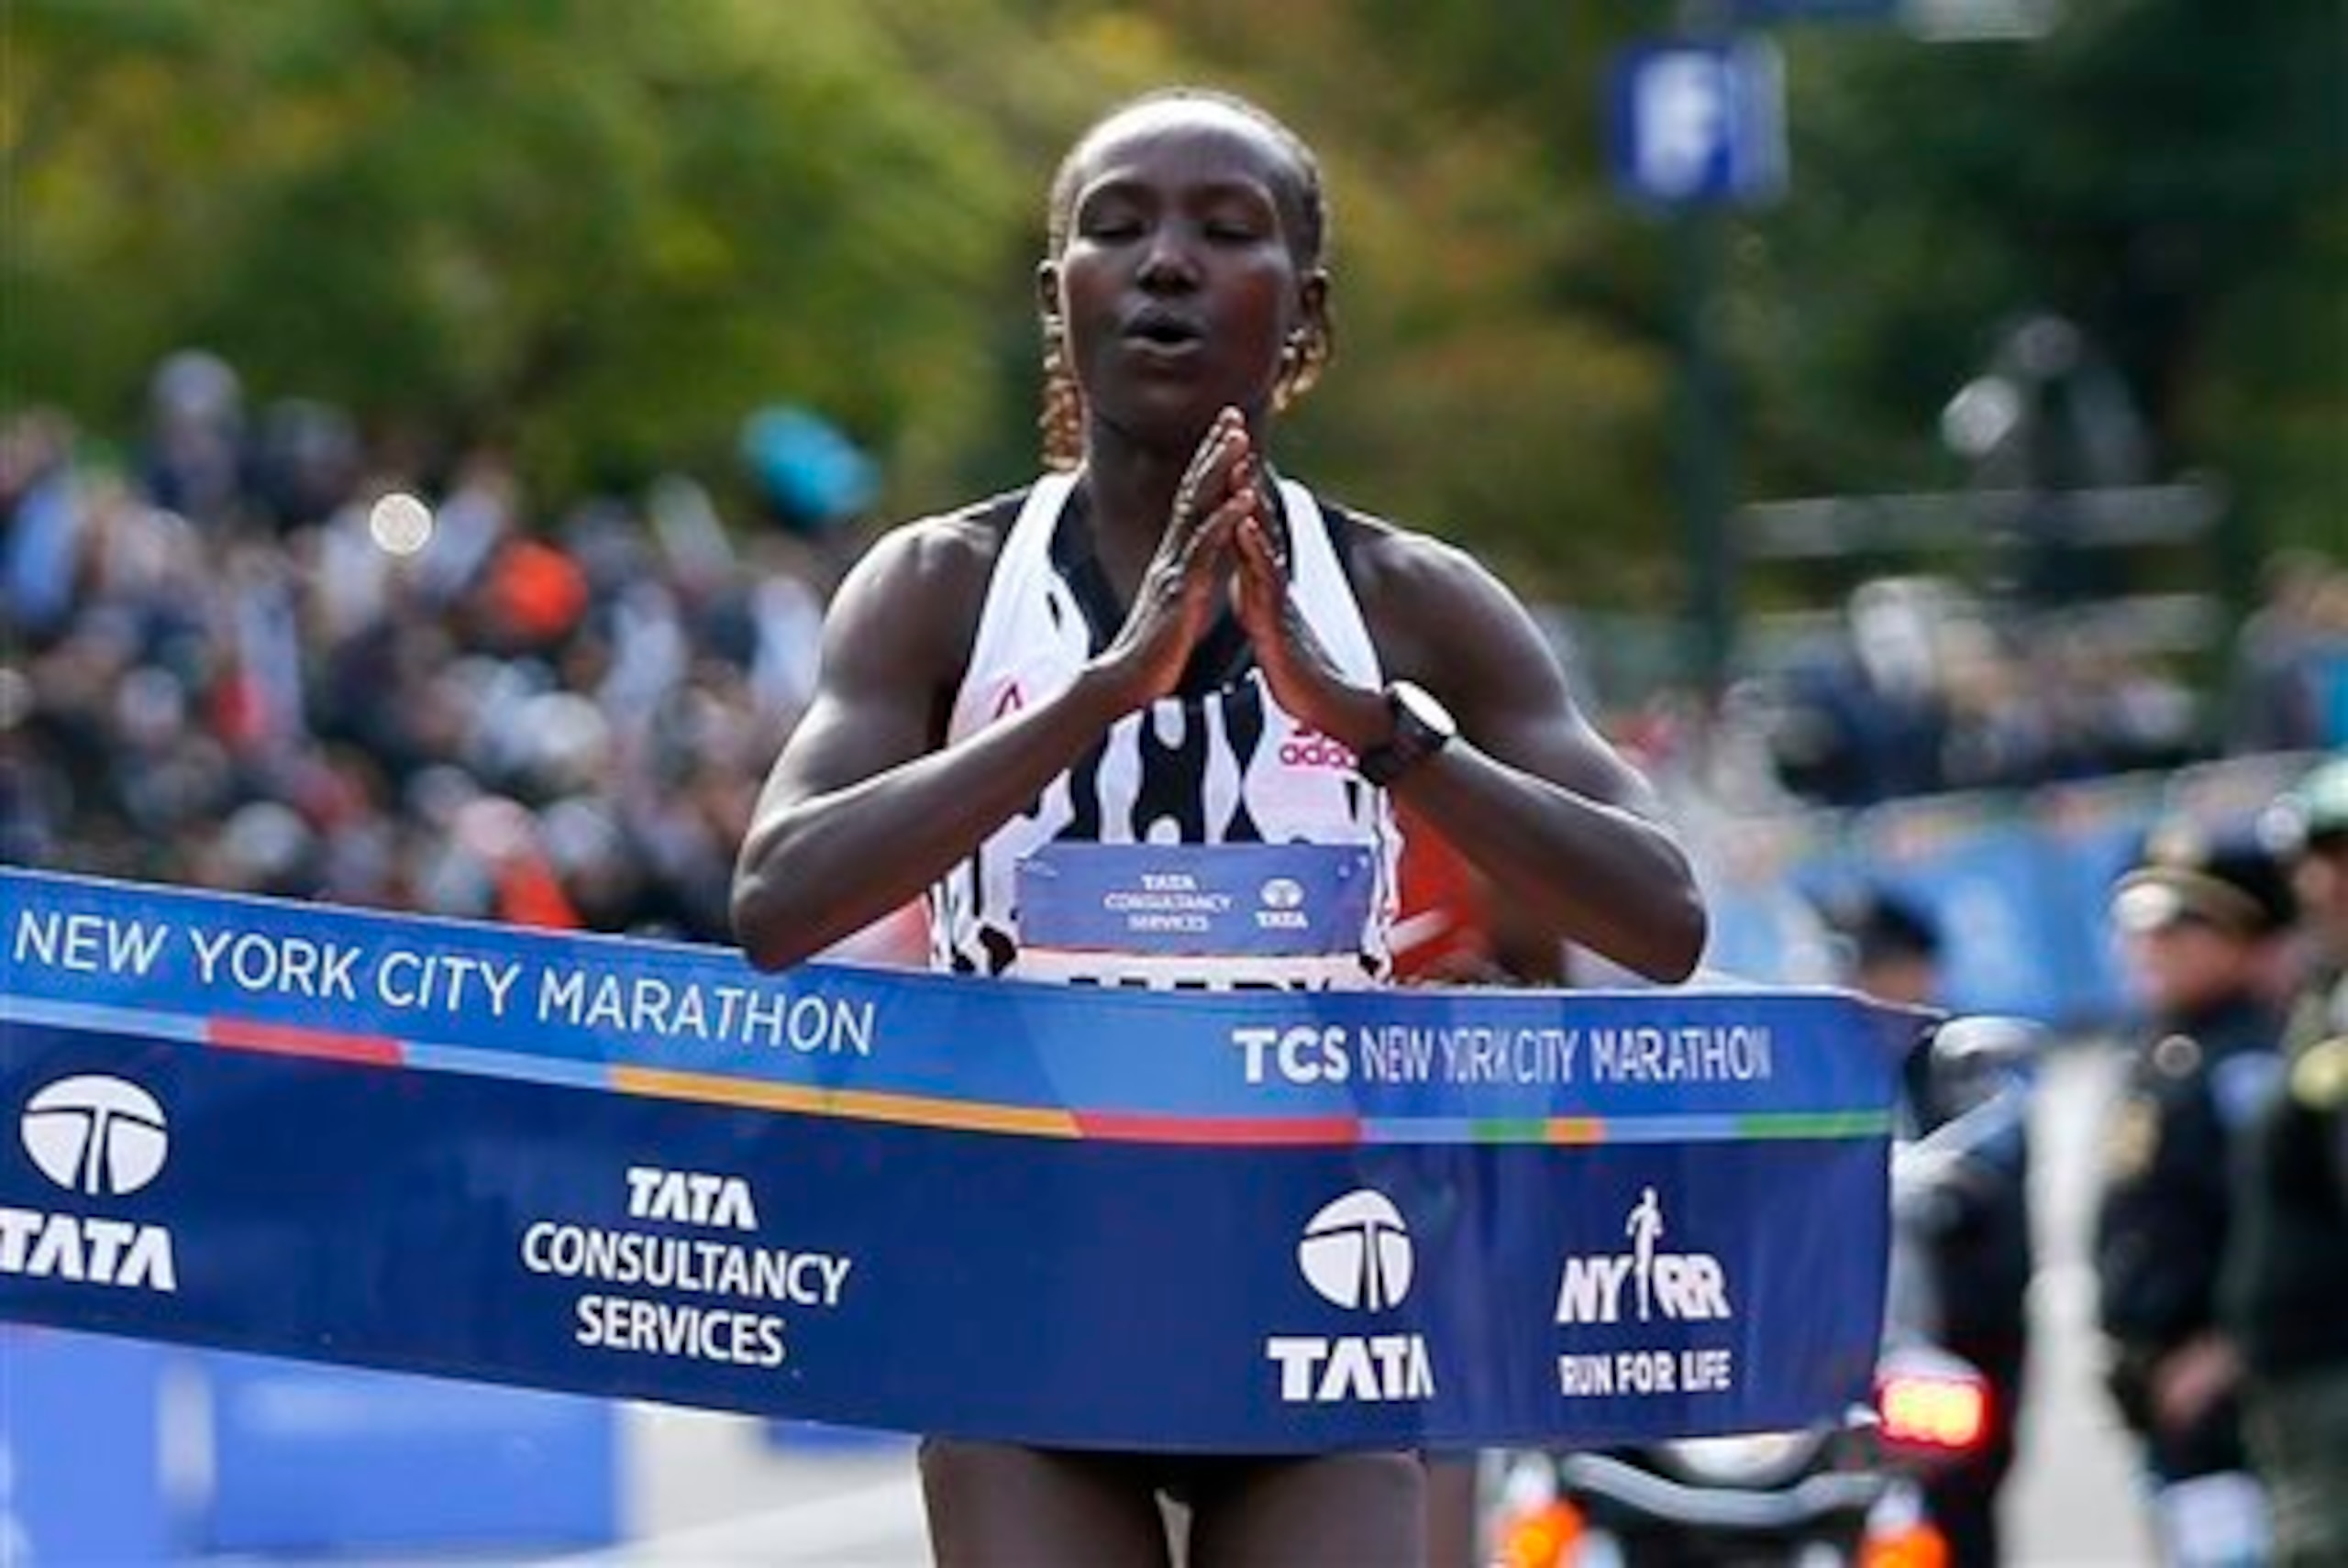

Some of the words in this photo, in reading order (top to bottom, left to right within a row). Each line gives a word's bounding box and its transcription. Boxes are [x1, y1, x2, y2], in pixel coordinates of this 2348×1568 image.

[15, 911, 167, 975] NEW
[189, 929, 360, 1001] YORK
[377, 951, 519, 1016] CITY
[538, 969, 875, 1055] MARATHON
[1232, 1026, 1347, 1084] TCS
[1358, 1029, 1433, 1084] NEW
[1515, 1028, 1579, 1085] CITY
[626, 1167, 758, 1231] TATA
[0, 1209, 176, 1290] TATA
[522, 1221, 850, 1306] CONSULTANCY
[576, 1294, 786, 1366] SERVICES
[1267, 1335, 1434, 1402] TATA
[1560, 1354, 1614, 1397] RUN
[1617, 1353, 1676, 1394] FOR
[1681, 1350, 1733, 1391] LIFE
